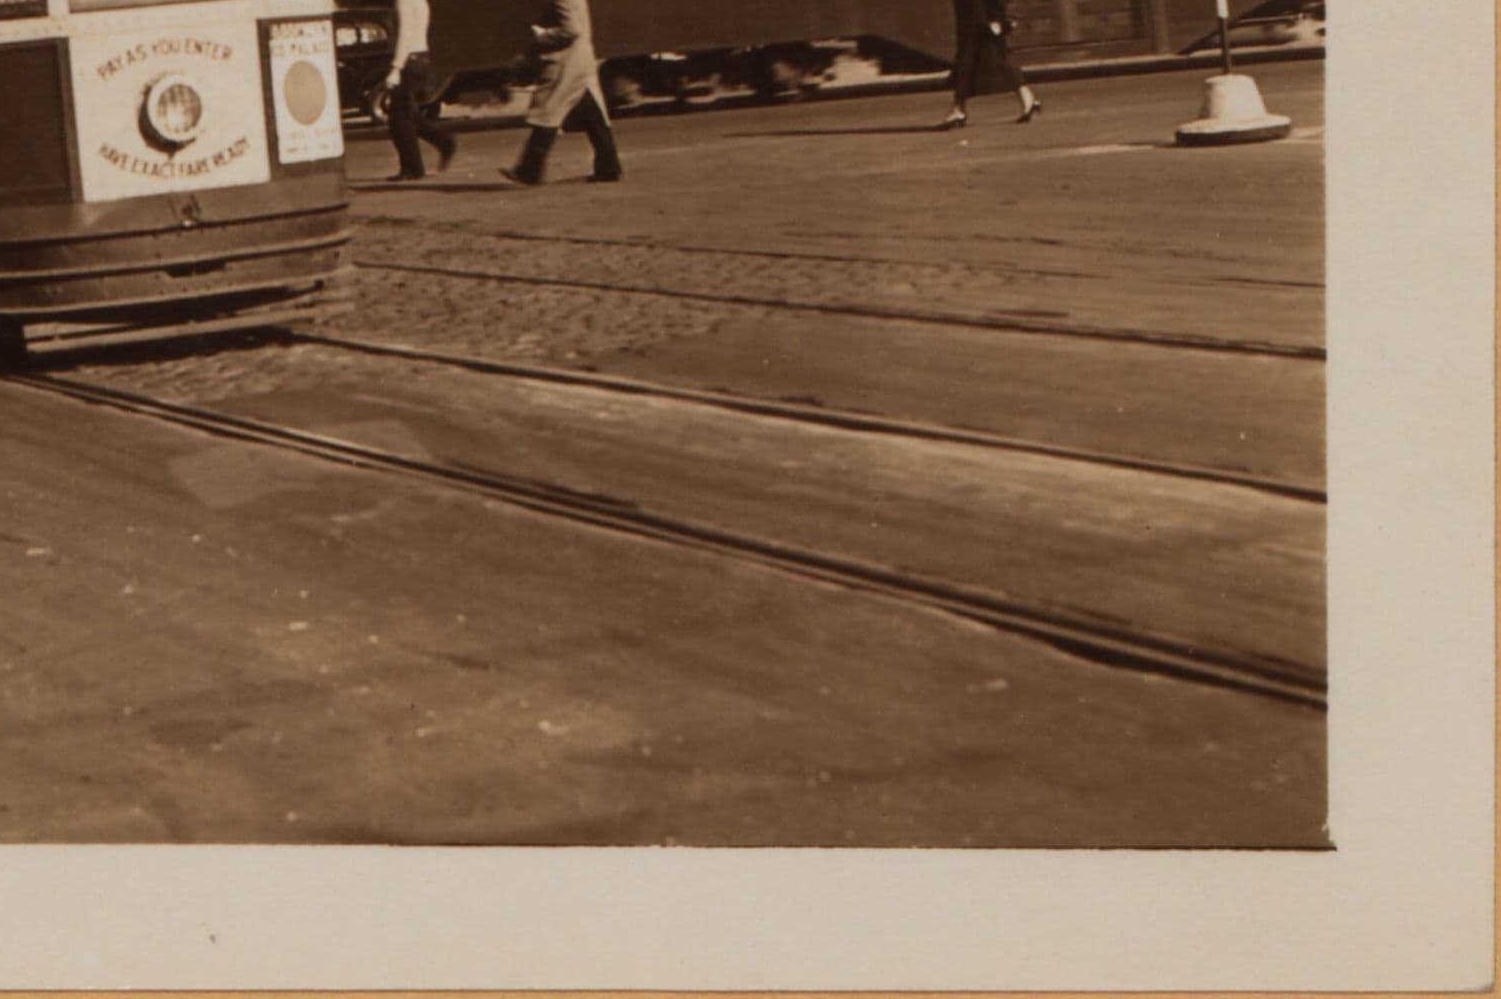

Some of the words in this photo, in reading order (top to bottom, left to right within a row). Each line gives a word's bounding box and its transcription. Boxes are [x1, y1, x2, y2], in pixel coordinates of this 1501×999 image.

[97, 57, 122, 81] PAY
[126, 44, 148, 65] AS
[151, 38, 181, 57] YOU
[185, 38, 233, 62] ENTER
[131, 157, 176, 180] EXACT
